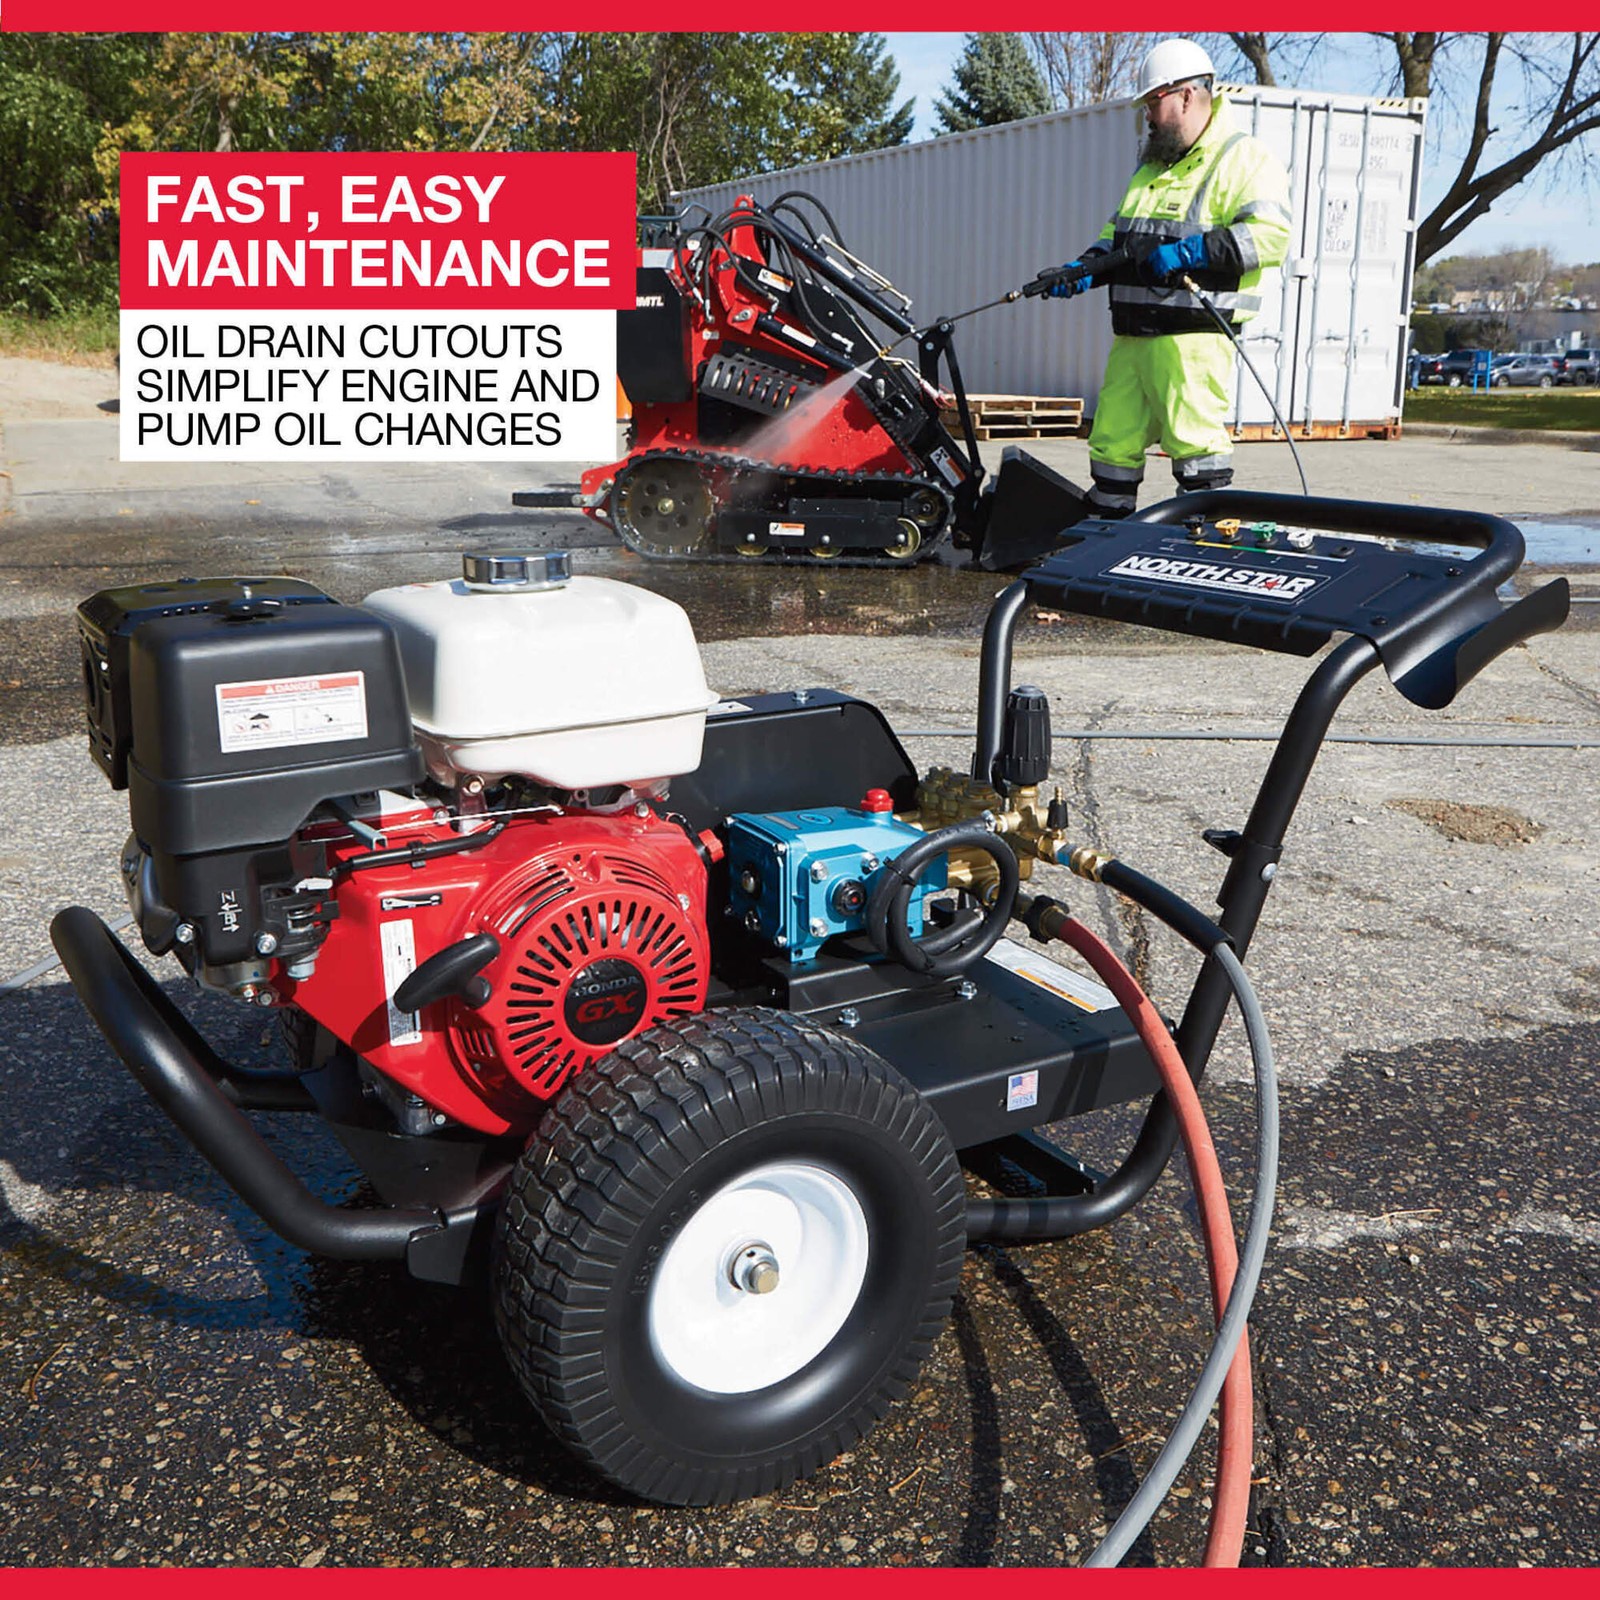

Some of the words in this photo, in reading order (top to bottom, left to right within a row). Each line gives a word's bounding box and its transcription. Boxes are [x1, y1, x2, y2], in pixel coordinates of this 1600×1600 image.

[274, 680, 321, 693] DANGER
[574, 976, 641, 997] HONDA
[576, 990, 639, 1023] GX
